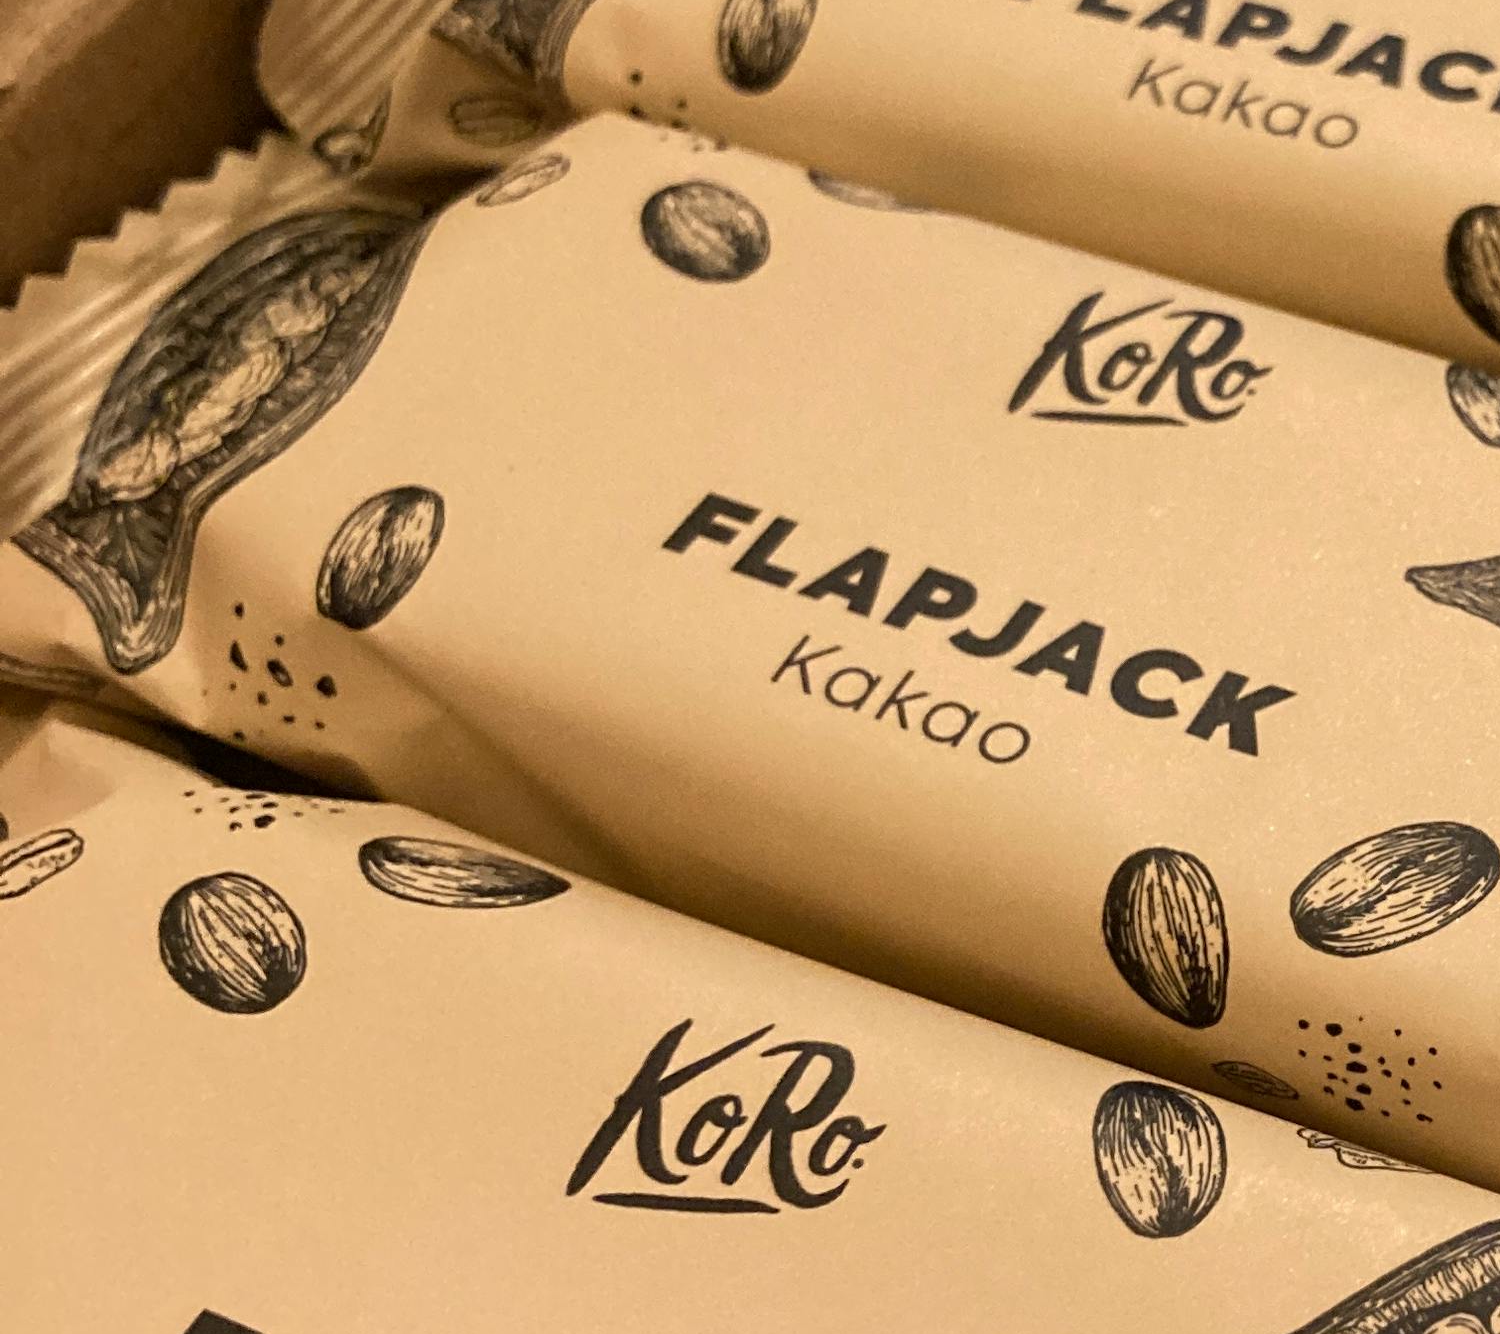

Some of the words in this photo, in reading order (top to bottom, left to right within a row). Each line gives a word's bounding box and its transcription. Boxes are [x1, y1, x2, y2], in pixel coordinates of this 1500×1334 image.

[1127, 58, 1359, 149] Kakao
[660, 491, 1298, 758] FLAPJACK
[770, 634, 1032, 765] Kakao
